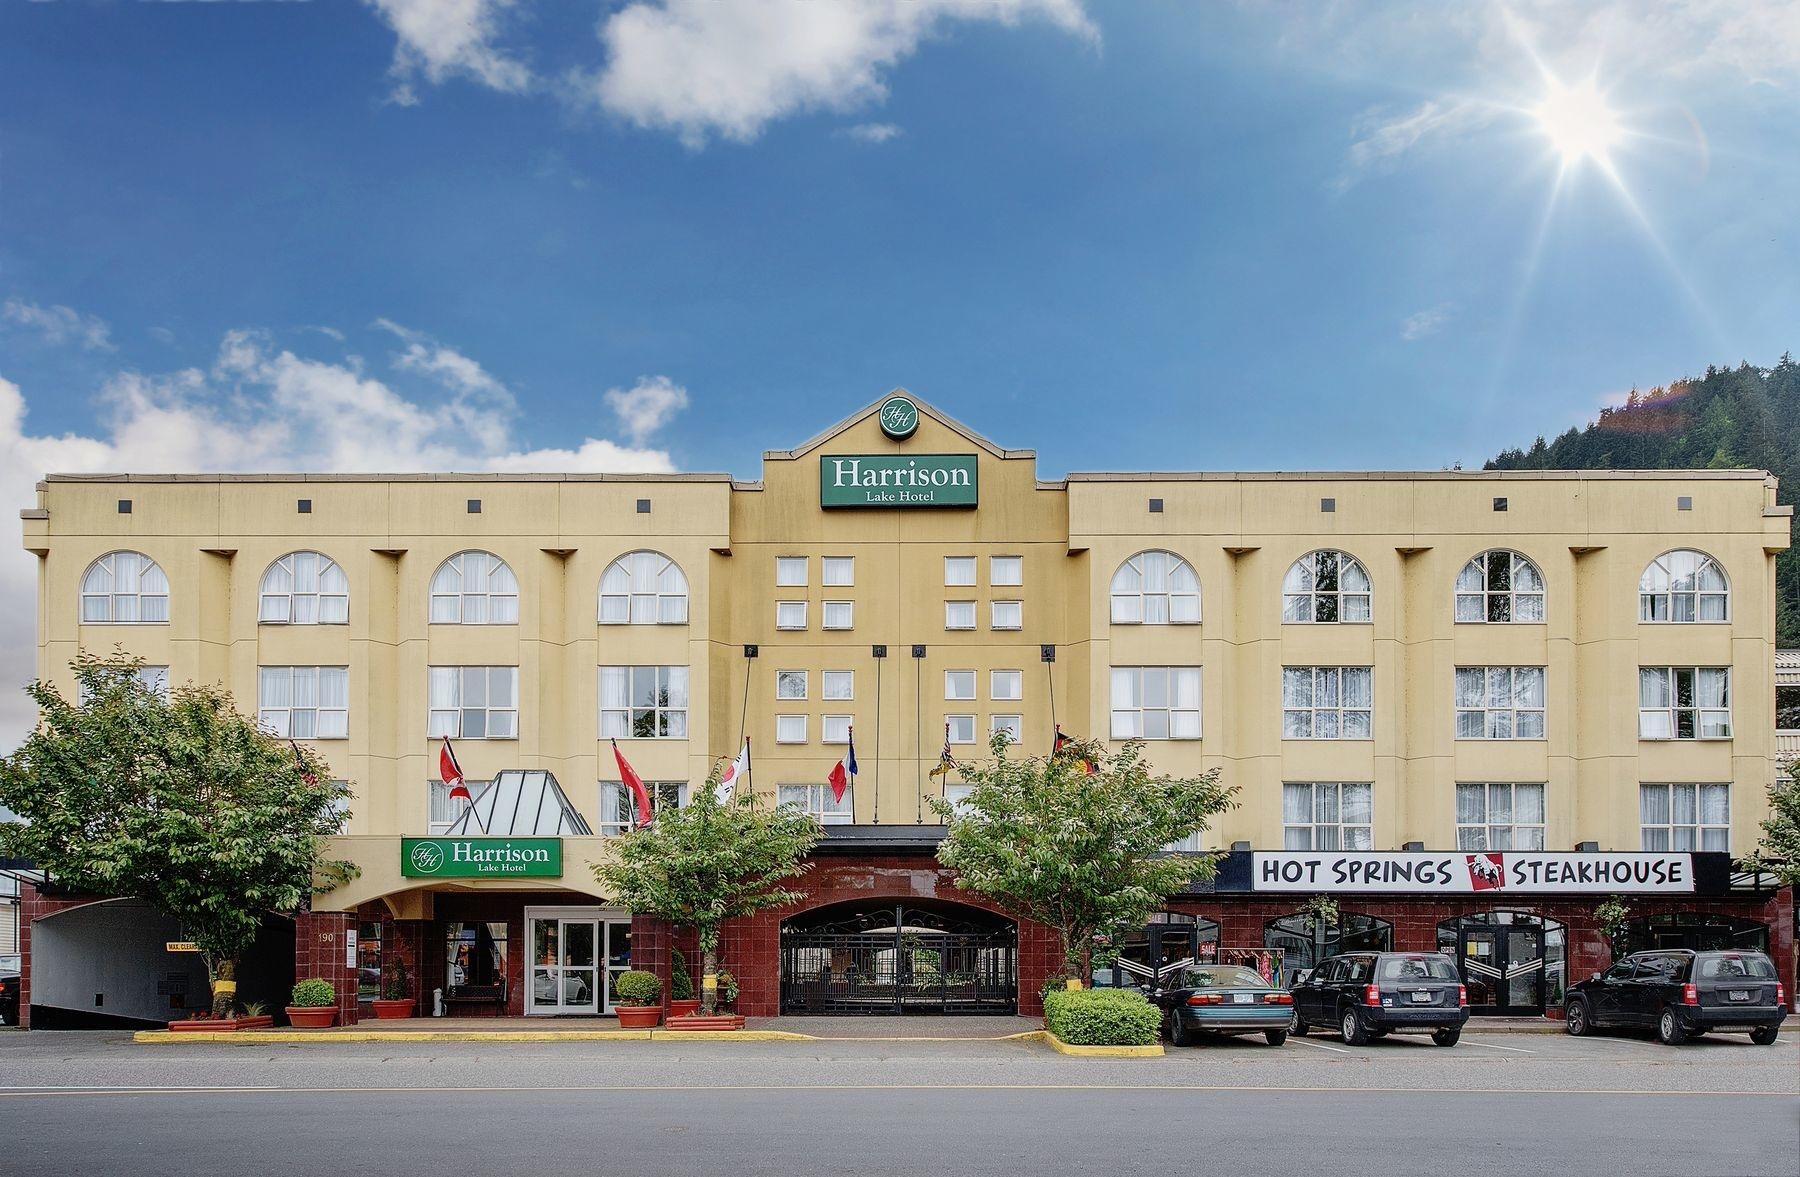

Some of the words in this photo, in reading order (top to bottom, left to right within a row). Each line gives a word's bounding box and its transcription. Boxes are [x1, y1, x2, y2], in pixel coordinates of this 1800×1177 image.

[832, 460, 971, 488] Harrison
[866, 491, 895, 502] Lake
[899, 491, 934, 502] Hotel
[452, 842, 550, 862] Harrison
[478, 863, 499, 872] Lake
[501, 863, 526, 872] Hotel
[1262, 860, 1321, 883] HOT
[1331, 858, 1453, 885] SPRINGS
[1512, 859, 1682, 885] STEAKHOUSE
[318, 933, 334, 942] 190
[1201, 944, 1216, 954] SALE
[1441, 946, 1456, 954] OPEN
